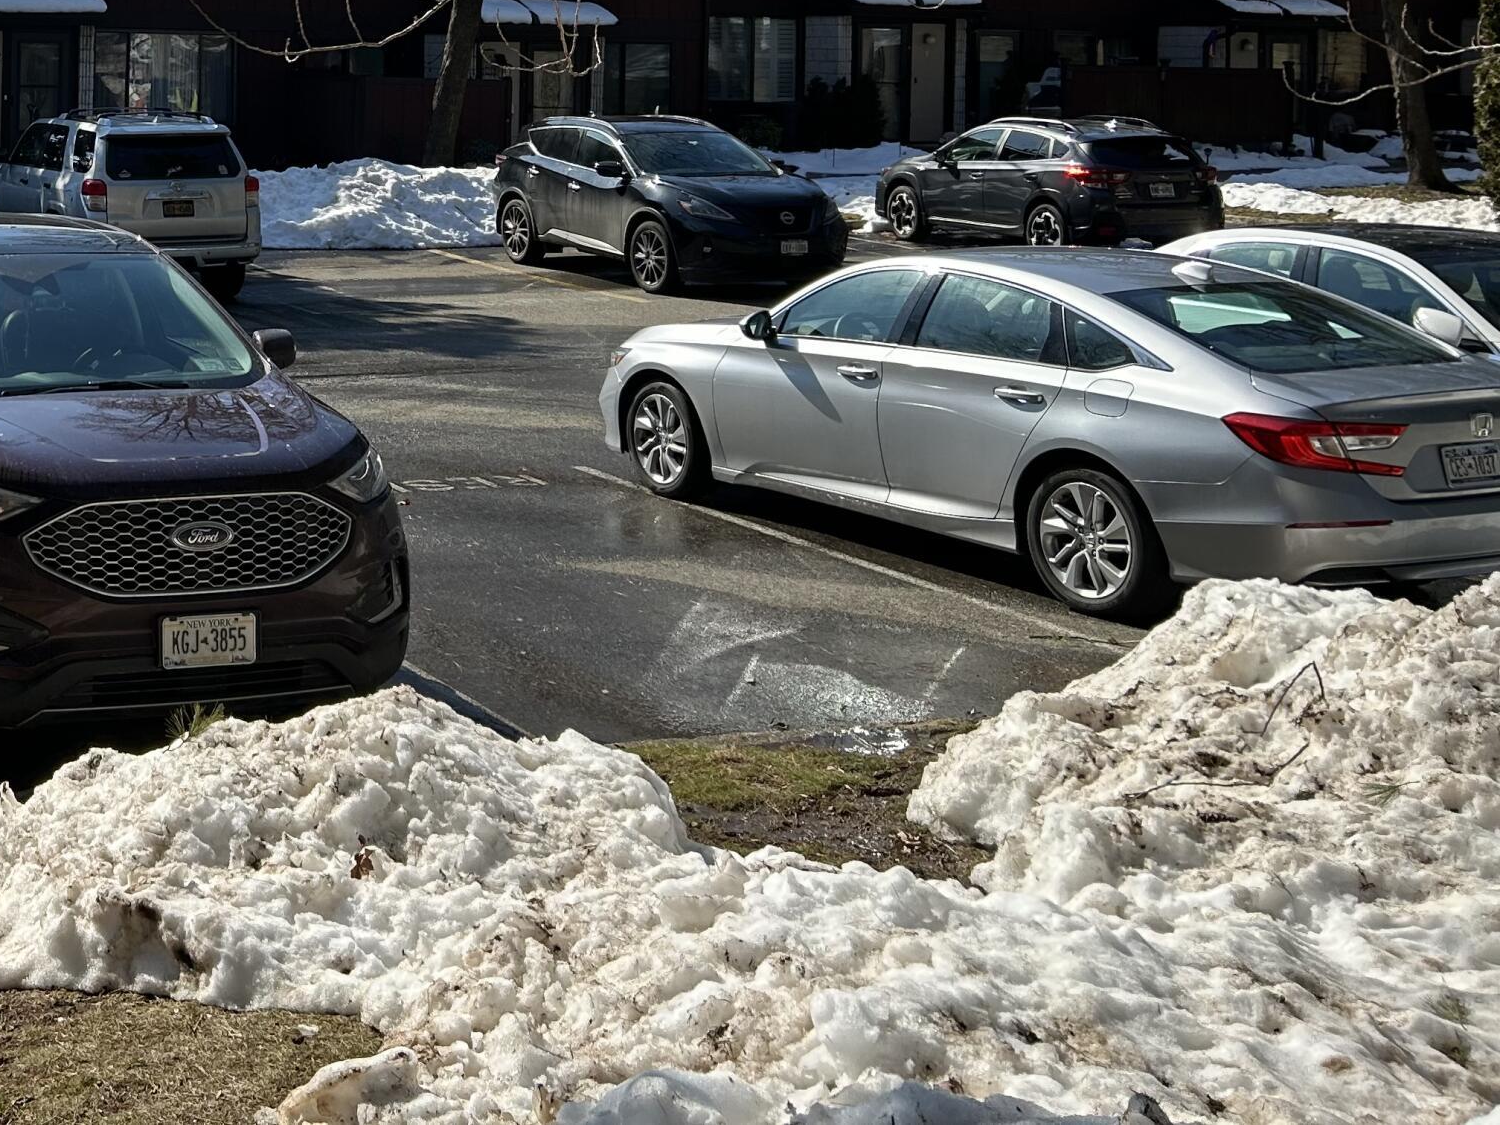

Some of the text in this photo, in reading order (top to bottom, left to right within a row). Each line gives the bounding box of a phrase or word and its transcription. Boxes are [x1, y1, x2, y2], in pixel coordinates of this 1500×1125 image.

[187, 528, 220, 544] Ford
[187, 618, 232, 629] NEW YORK
